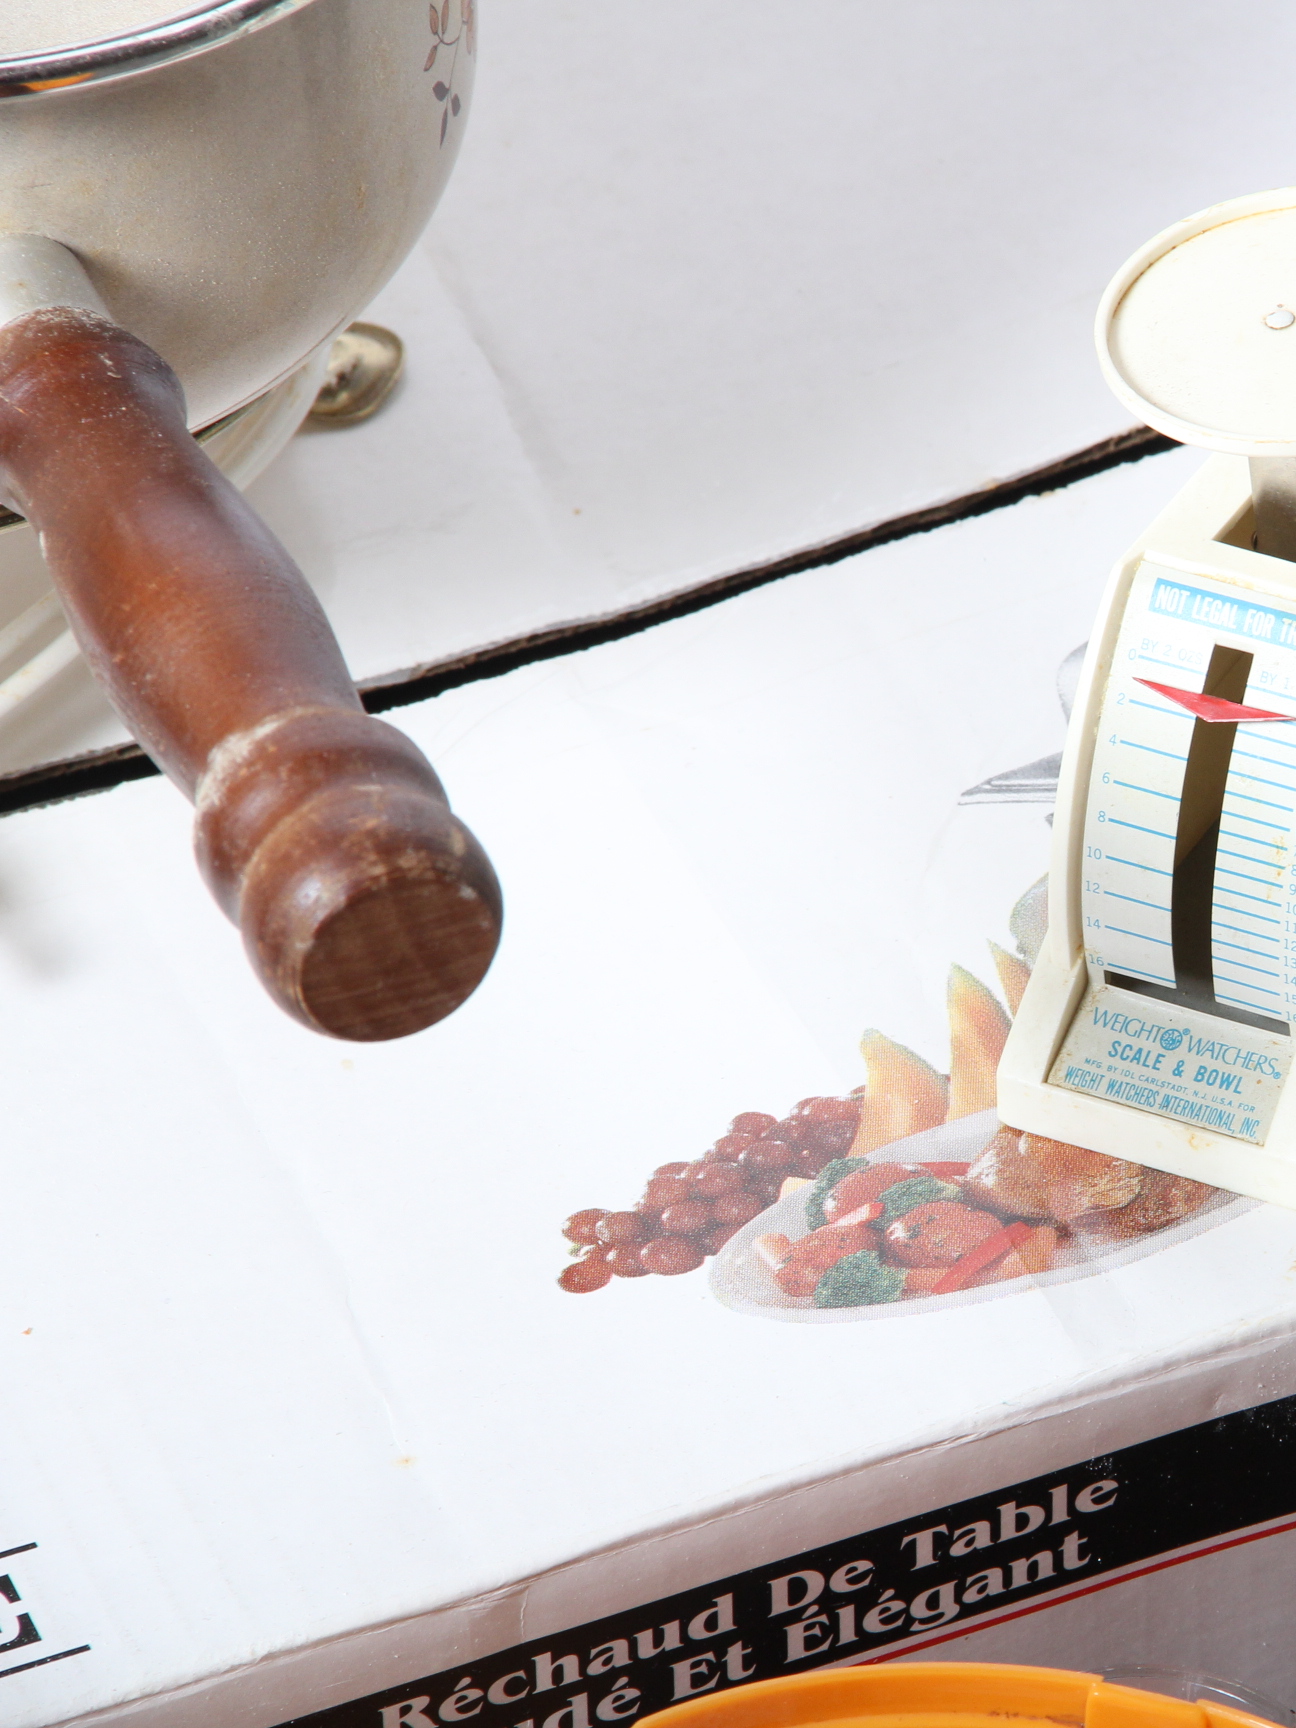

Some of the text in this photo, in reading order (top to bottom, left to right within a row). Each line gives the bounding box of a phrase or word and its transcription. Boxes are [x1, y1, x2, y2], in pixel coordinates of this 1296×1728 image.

[1154, 584, 1190, 614] NOT
[1191, 595, 1238, 629] LEGAL
[1243, 608, 1276, 639] FOR
[1141, 638, 1158, 652] BY
[1164, 645, 1171, 656] 2
[1129, 649, 1137, 661] 0
[1260, 671, 1277, 685] BY
[1283, 677, 1290, 689] 1
[1117, 694, 1125, 705] 2
[1109, 735, 1117, 746] 4
[1102, 773, 1110, 784] 6
[1097, 811, 1106, 822] 8
[1086, 847, 1102, 860] 10
[1086, 881, 1100, 894] 12
[1289, 884, 1296, 895] 9
[1086, 916, 1101, 929] 14
[1088, 953, 1104, 966] 16
[1093, 1007, 1165, 1043] WEIGHT
[1108, 1040, 1243, 1095] SCALE & BOWL
[1084, 1058, 1102, 1068] MFG.
[1107, 1065, 1118, 1073] BY
[1121, 1069, 1135, 1079] IDL
[1193, 1090, 1206, 1100] N.J.
[1211, 1095, 1233, 1108] U.S.A.
[1237, 1103, 1256, 1113] FOR
[1064, 1065, 1259, 1139] WEIGHT WATCHERS INTERNATIONAL, INC.
[378, 1478, 1119, 1728] Réchaud De Table
[671, 1640, 758, 1701] Et
[781, 1530, 1092, 1665] Élégant
